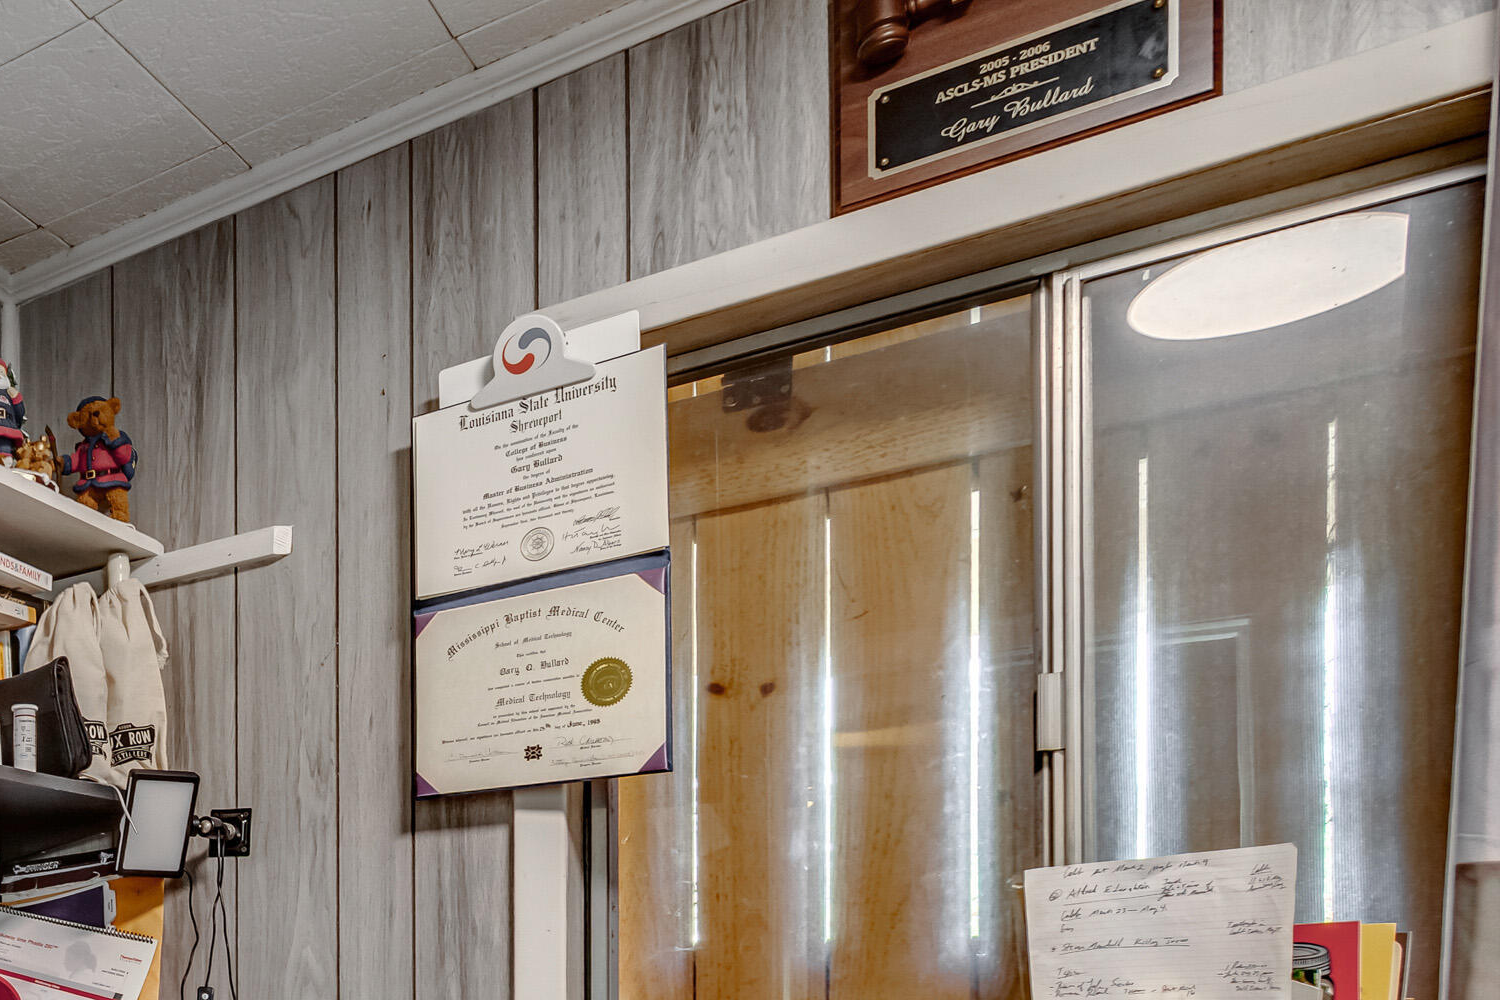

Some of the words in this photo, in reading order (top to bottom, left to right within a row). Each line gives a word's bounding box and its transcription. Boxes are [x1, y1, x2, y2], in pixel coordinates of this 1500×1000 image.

[935, 70, 1007, 103] ASCLS-MS
[1010, 37, 1100, 79] PRESIDENT
[979, 57, 1009, 74] 2005
[1020, 41, 1050, 60] 2006
[941, 114, 999, 142] Gary
[1004, 77, 1095, 118] Bullard
[457, 404, 515, 431] Louisiana
[516, 392, 549, 414] State
[552, 374, 618, 404] University
[507, 408, 563, 434] Shreveport
[509, 461, 531, 474] Gary
[532, 453, 563, 468] Bullard
[446, 618, 501, 660] Mississippi
[504, 606, 543, 627] Baptist
[546, 604, 589, 621] Medical
[591, 610, 626, 634] Center
[493, 692, 525, 709] Medical
[527, 685, 571, 707] Technology
[128, 729, 151, 746] ROW
